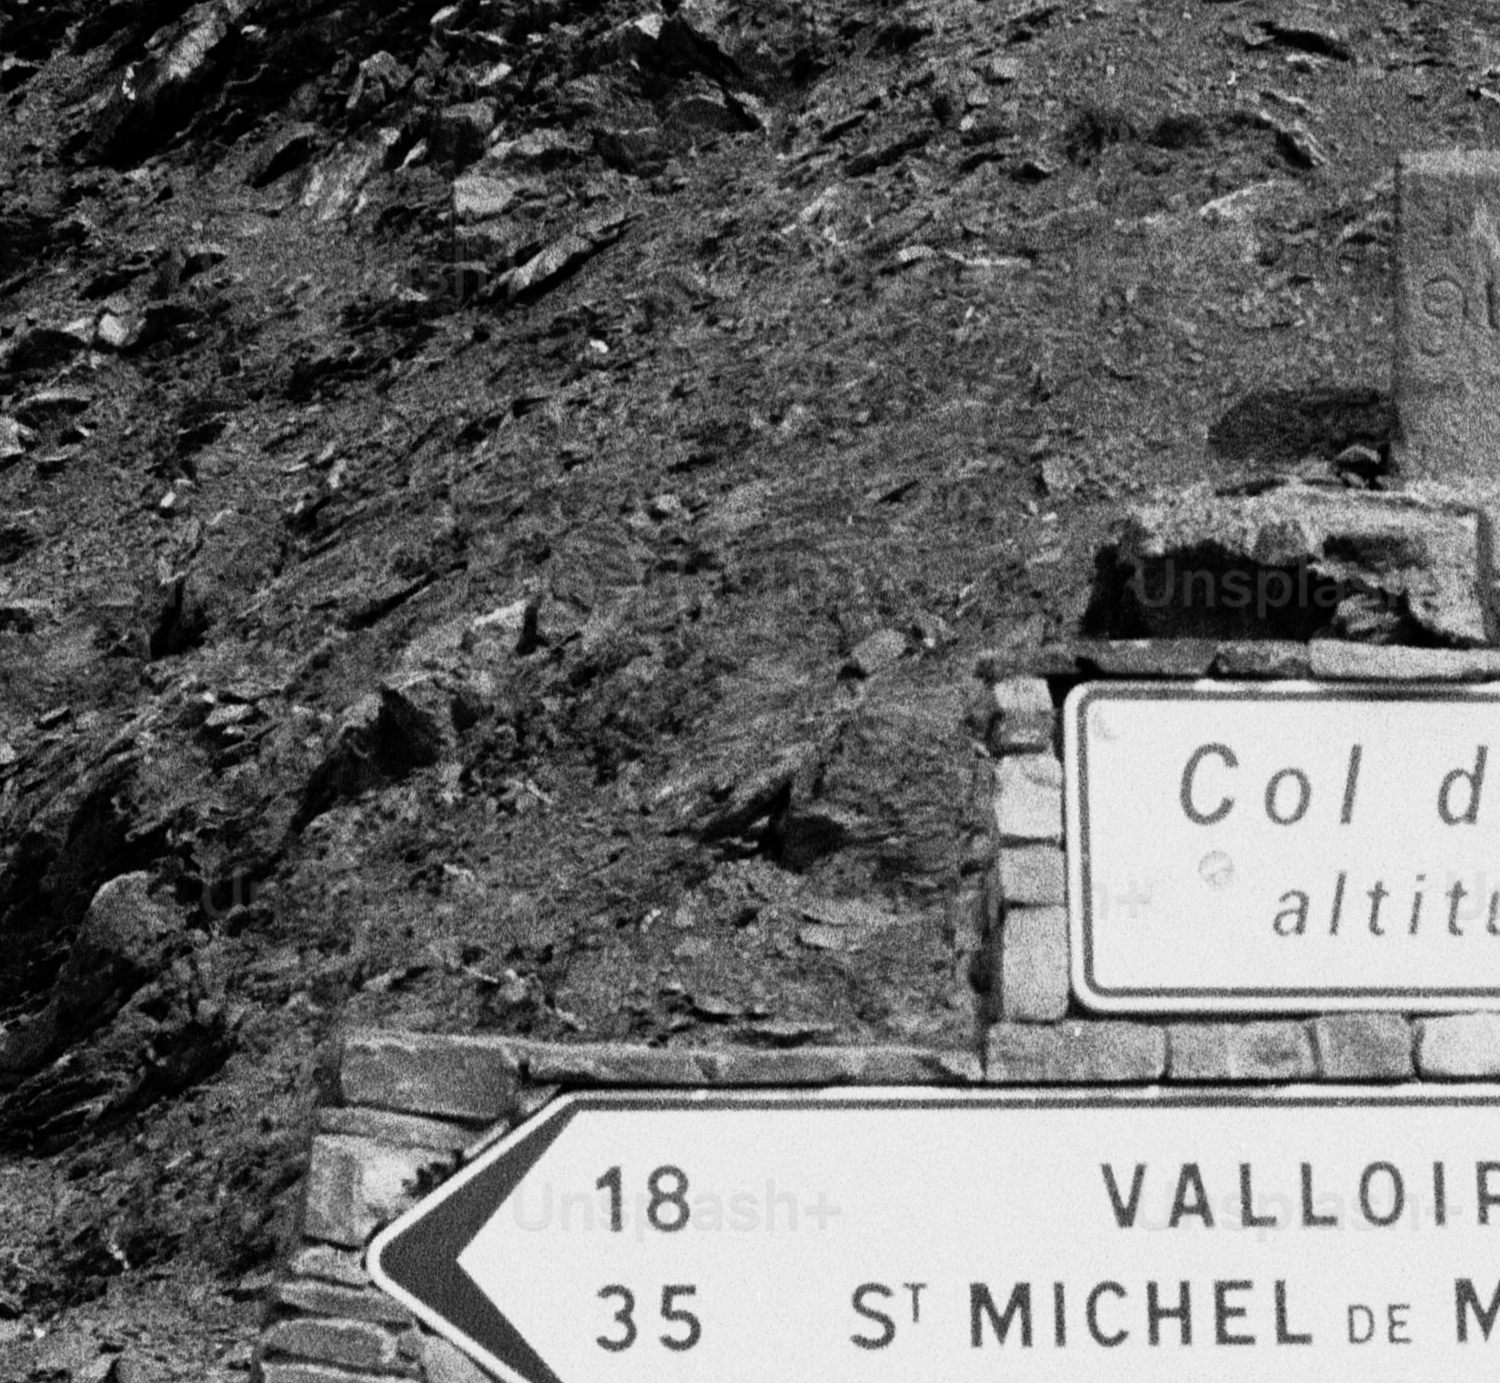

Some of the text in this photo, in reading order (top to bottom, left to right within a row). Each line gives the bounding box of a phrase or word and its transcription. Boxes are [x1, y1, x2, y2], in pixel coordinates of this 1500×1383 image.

[1178, 742, 1363, 827] Col
[594, 1164, 692, 1234] 18
[594, 1283, 705, 1354] 35
[968, 1277, 1315, 1349] MICHEL
[1346, 1302, 1413, 1345] DE
